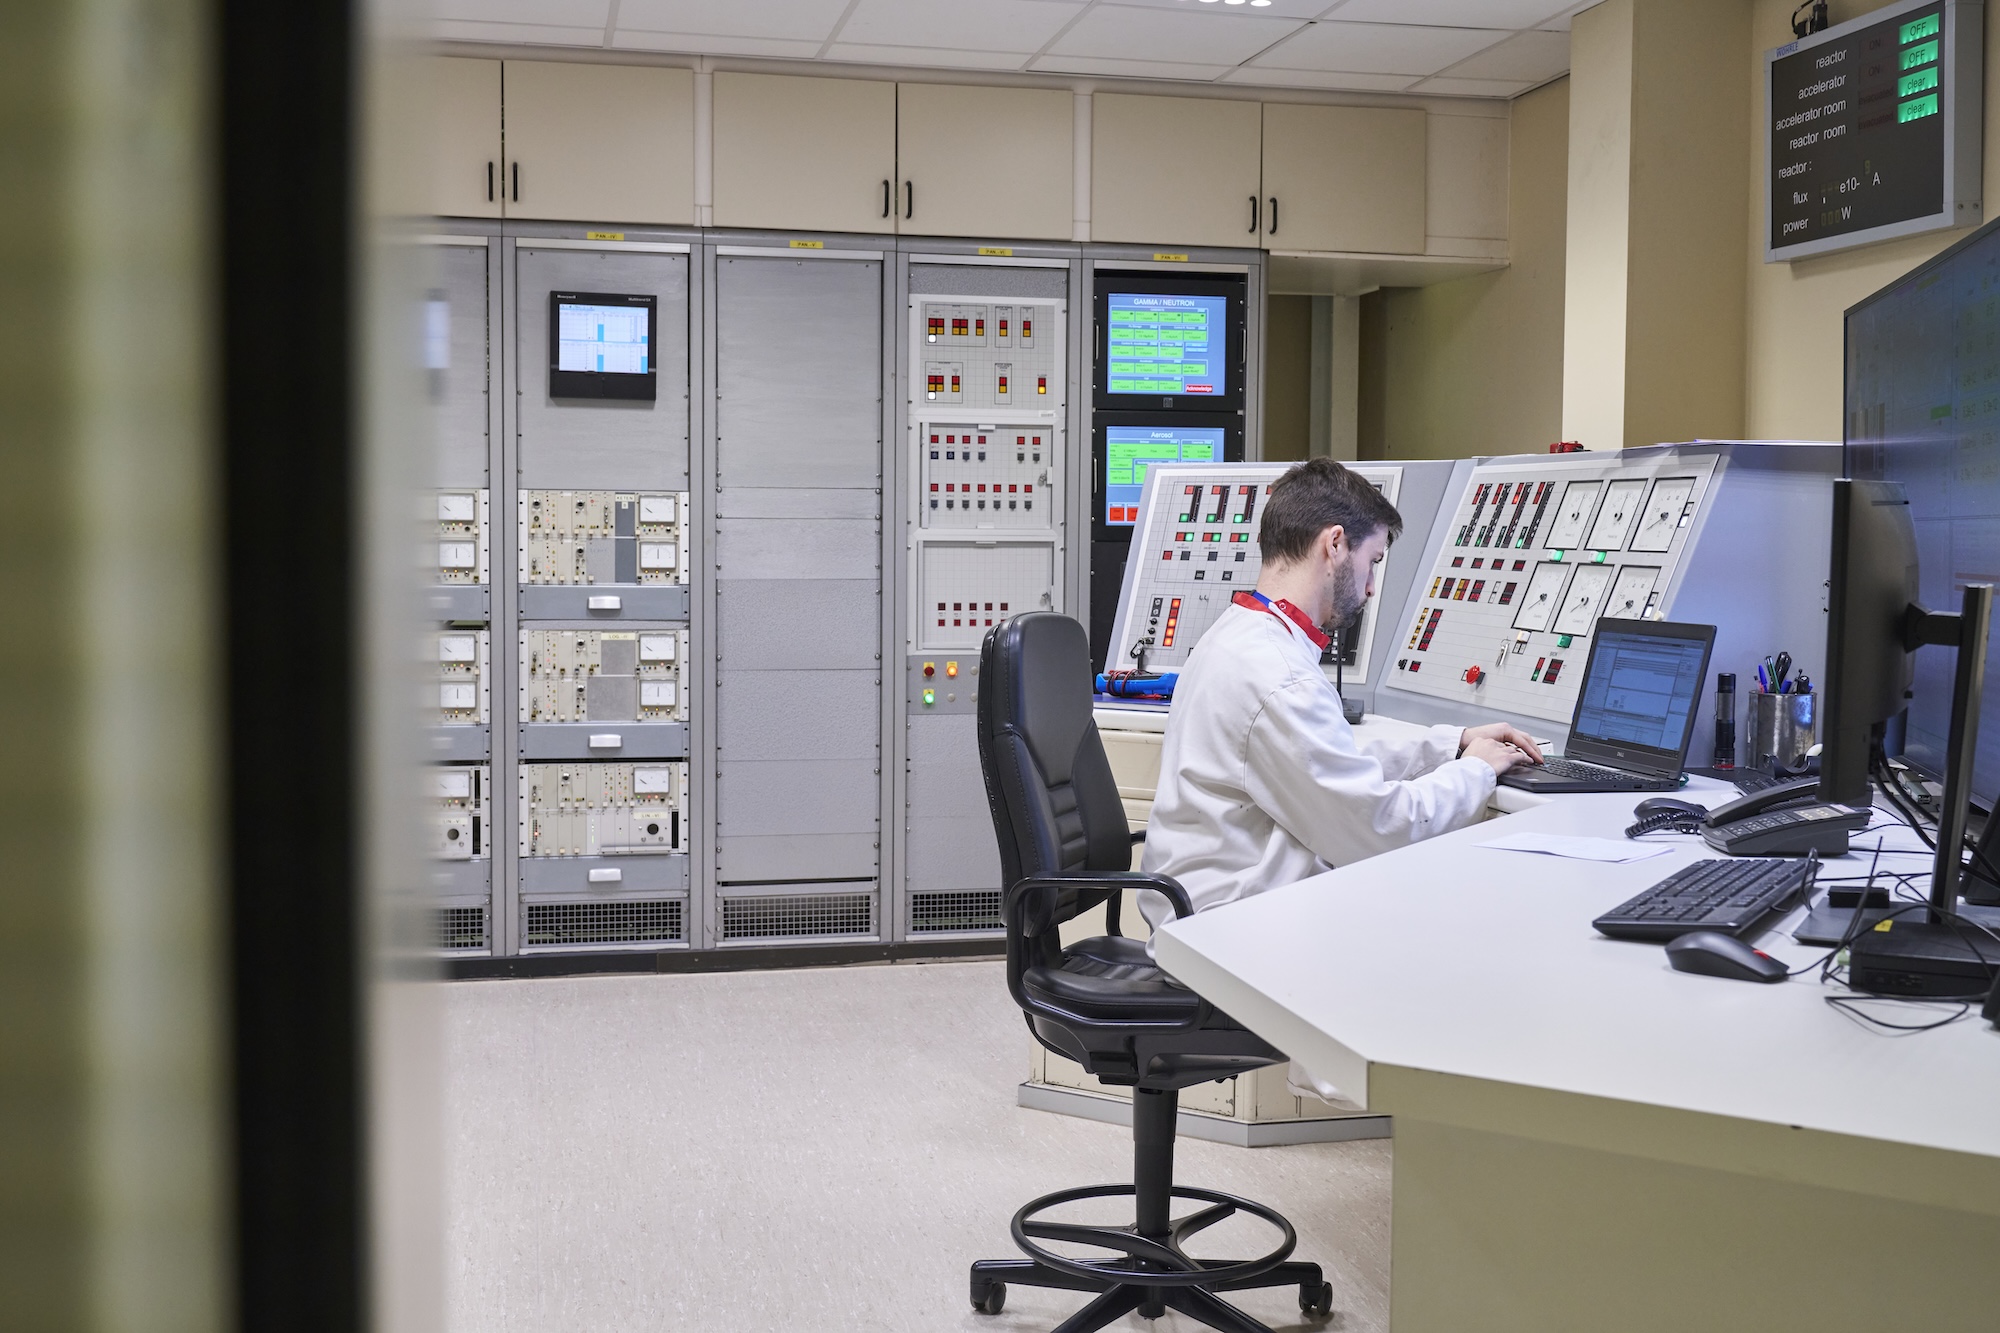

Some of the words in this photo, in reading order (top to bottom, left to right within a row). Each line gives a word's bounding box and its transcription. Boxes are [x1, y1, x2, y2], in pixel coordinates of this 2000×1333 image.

[1909, 22, 1927, 37] OFF
[1815, 49, 1847, 69] reactor
[1908, 49, 1926, 64] OFF
[1798, 74, 1847, 100] accelerator
[1907, 75, 1926, 89] clear
[1775, 107, 1822, 131] accelerator
[1823, 99, 1847, 116] room
[1906, 102, 1926, 116] clear
[1789, 130, 1819, 150] reactor
[1823, 123, 1847, 140] room
[1778, 160, 1808, 179] reactor
[1793, 192, 1809, 205] flux
[1872, 171, 1881, 186] A
[1783, 217, 1809, 236] power
[1841, 205, 1851, 220] W
[1133, 298, 1159, 306] GAMMA
[1163, 299, 1195, 307] NEUTRON
[1150, 431, 1173, 439] Aerosol
